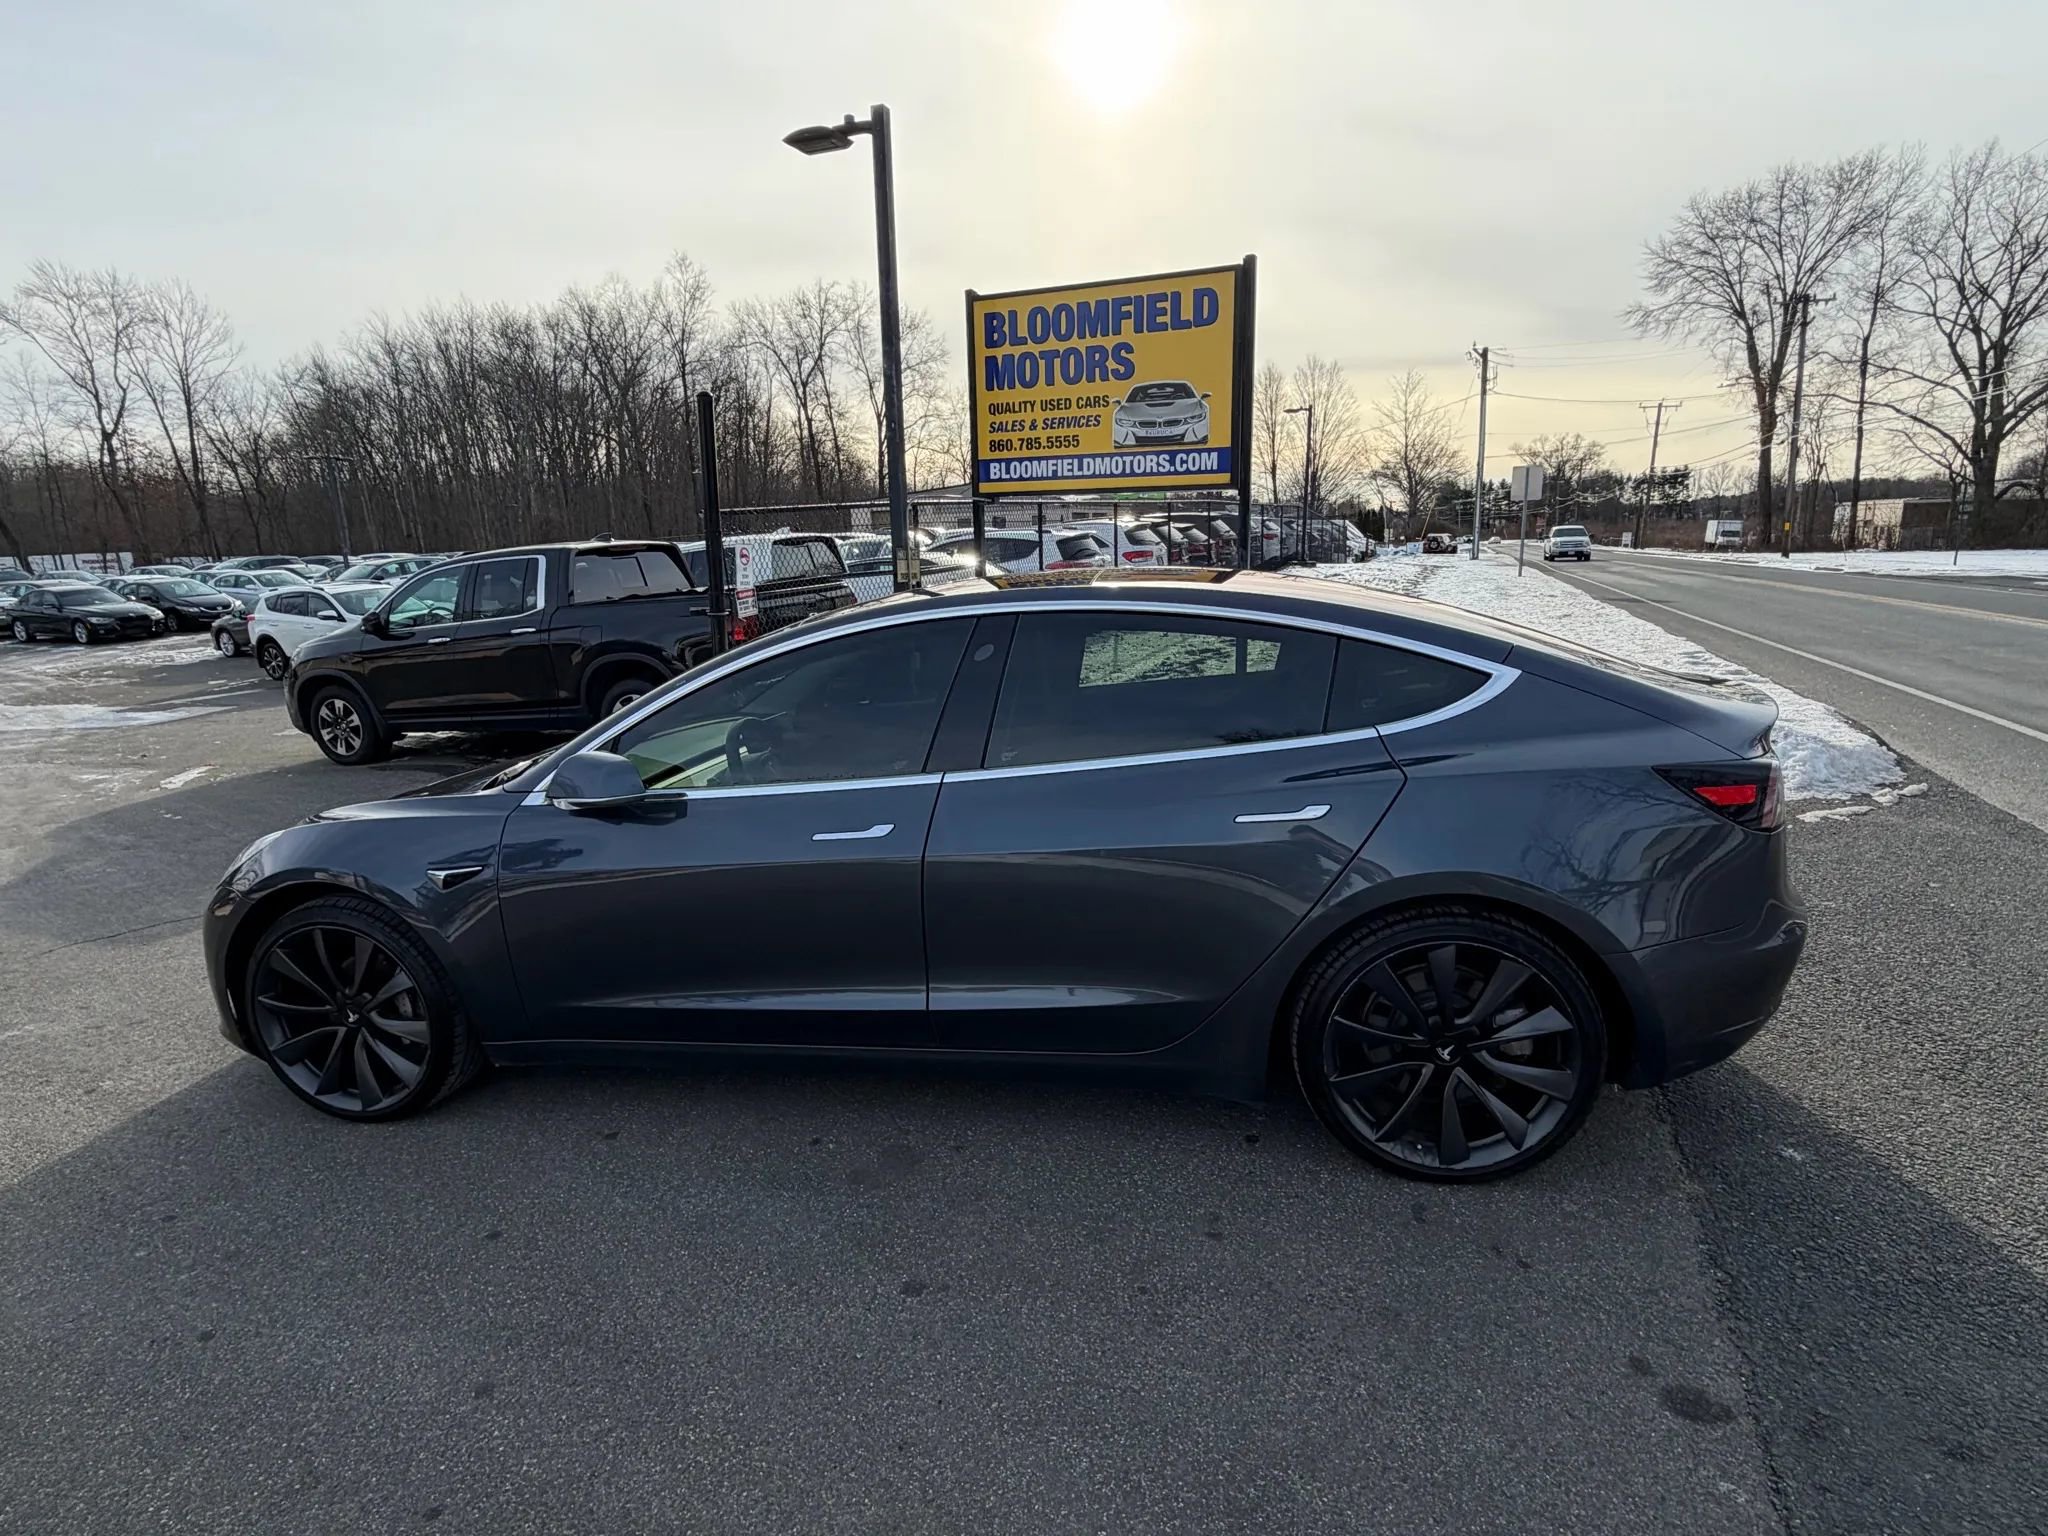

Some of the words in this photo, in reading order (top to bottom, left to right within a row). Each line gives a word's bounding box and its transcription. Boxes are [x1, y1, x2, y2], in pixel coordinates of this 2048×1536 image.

[983, 287, 1219, 349] BLOOMFIELD
[984, 341, 1136, 392] MOTORS
[988, 400, 1036, 416] QUALITY
[1040, 397, 1072, 413] USED
[1075, 394, 1110, 410] CARS
[988, 418, 1025, 434] SALES
[1028, 416, 1039, 431] &
[1041, 414, 1102, 430] SERVICES
[988, 434, 1080, 453] 860.785.5555
[989, 451, 1218, 480] BLOOMFIELDMOTORS.COM
